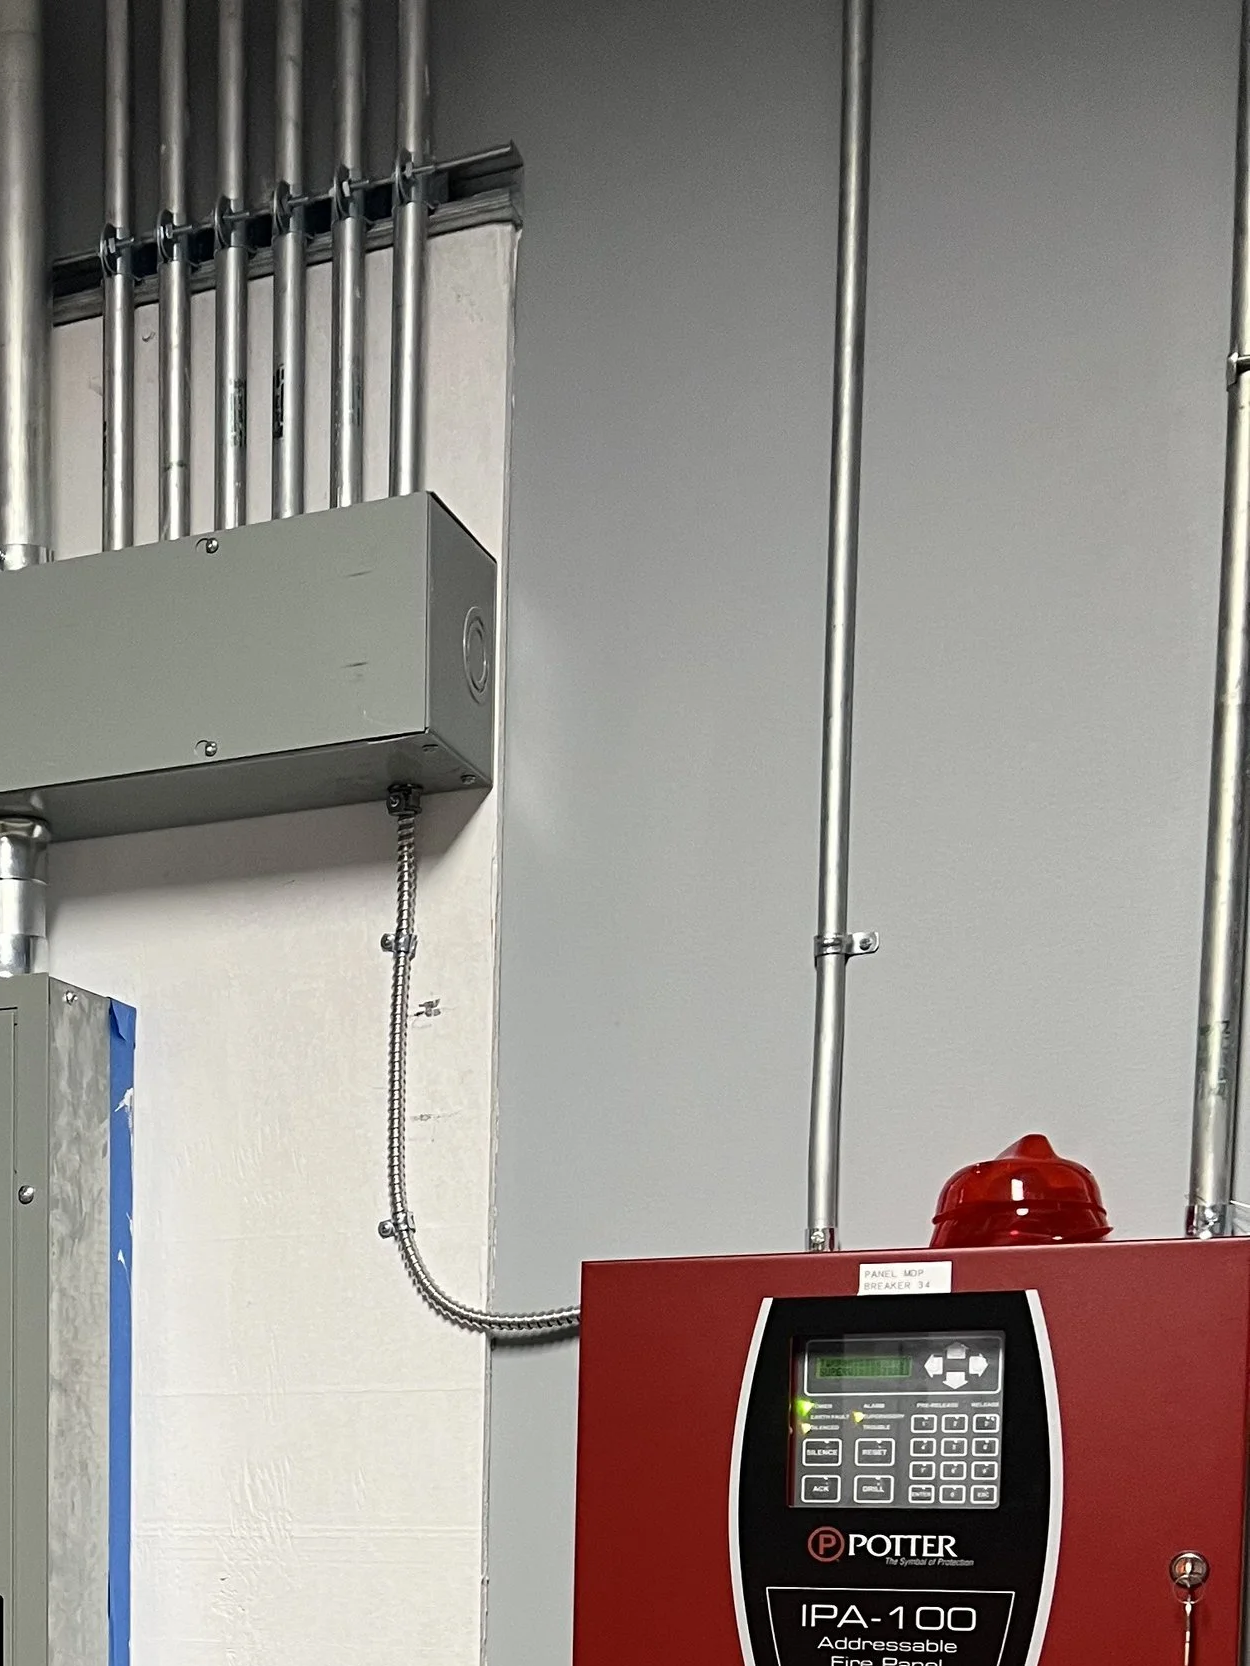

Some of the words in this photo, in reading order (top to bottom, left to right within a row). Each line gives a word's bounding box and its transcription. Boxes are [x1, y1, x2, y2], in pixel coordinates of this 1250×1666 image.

[864, 1270, 897, 1279] PANEL
[903, 1269, 925, 1278] MDP
[863, 1281, 911, 1291] BREAKER
[918, 1280, 931, 1290] 34
[848, 1533, 958, 1557] POTTER
[885, 1557, 899, 1566] The
[899, 1557, 928, 1568] Symbol
[928, 1558, 937, 1566] of
[937, 1558, 975, 1567] Protection
[801, 1604, 977, 1632] IPA-100
[817, 1636, 958, 1653] Addressable
